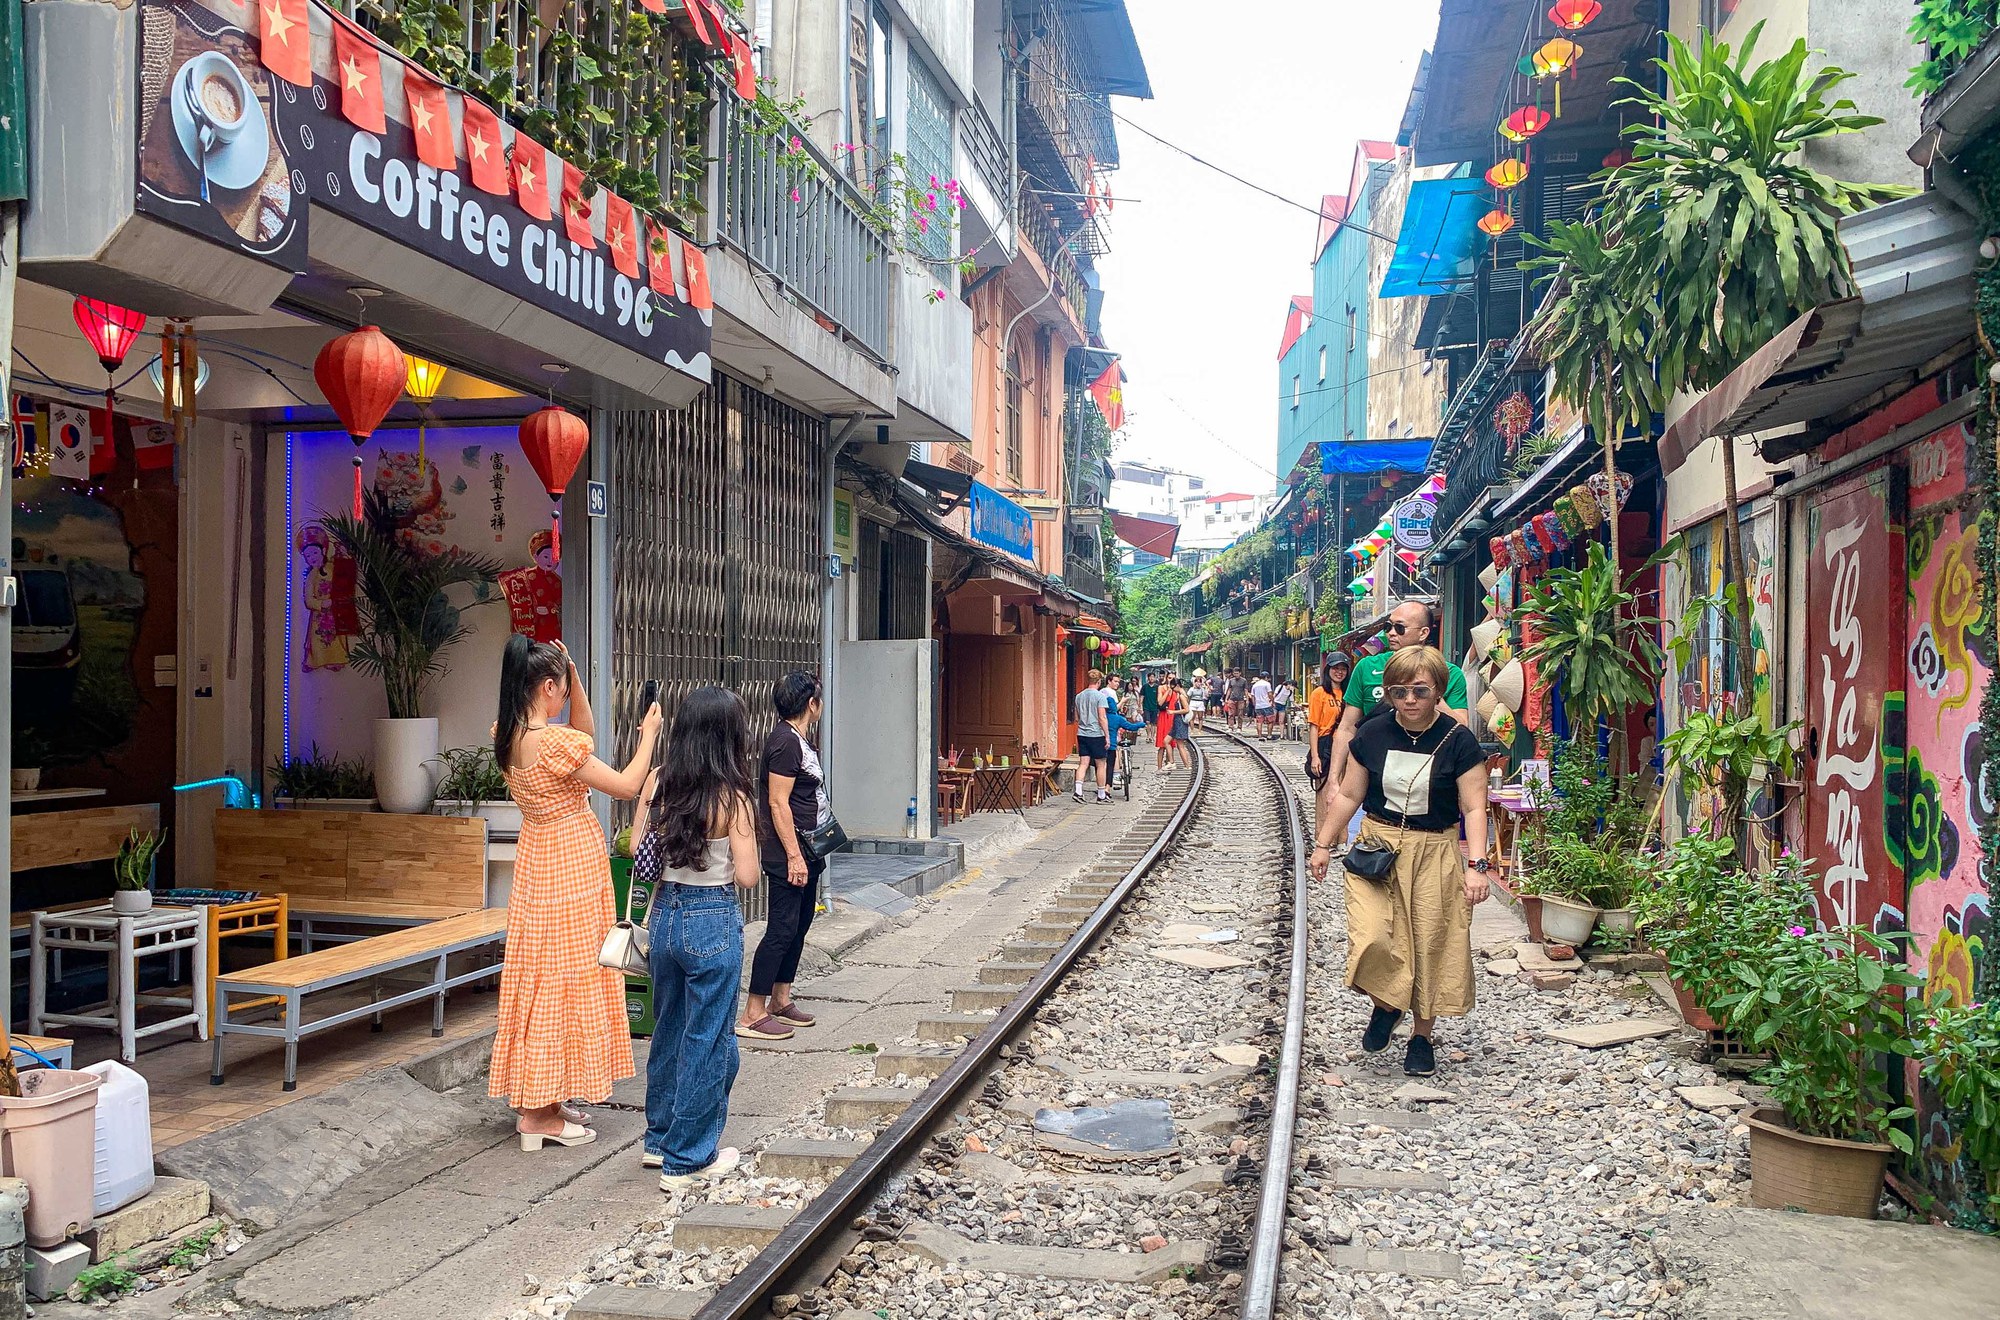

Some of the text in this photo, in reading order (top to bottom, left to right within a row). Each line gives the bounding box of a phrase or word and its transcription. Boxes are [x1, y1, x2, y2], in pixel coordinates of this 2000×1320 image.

[348, 130, 654, 337] Coffee Chill 96
[489, 451, 506, 532] 富貴吉祥
[591, 487, 603, 511] 96
